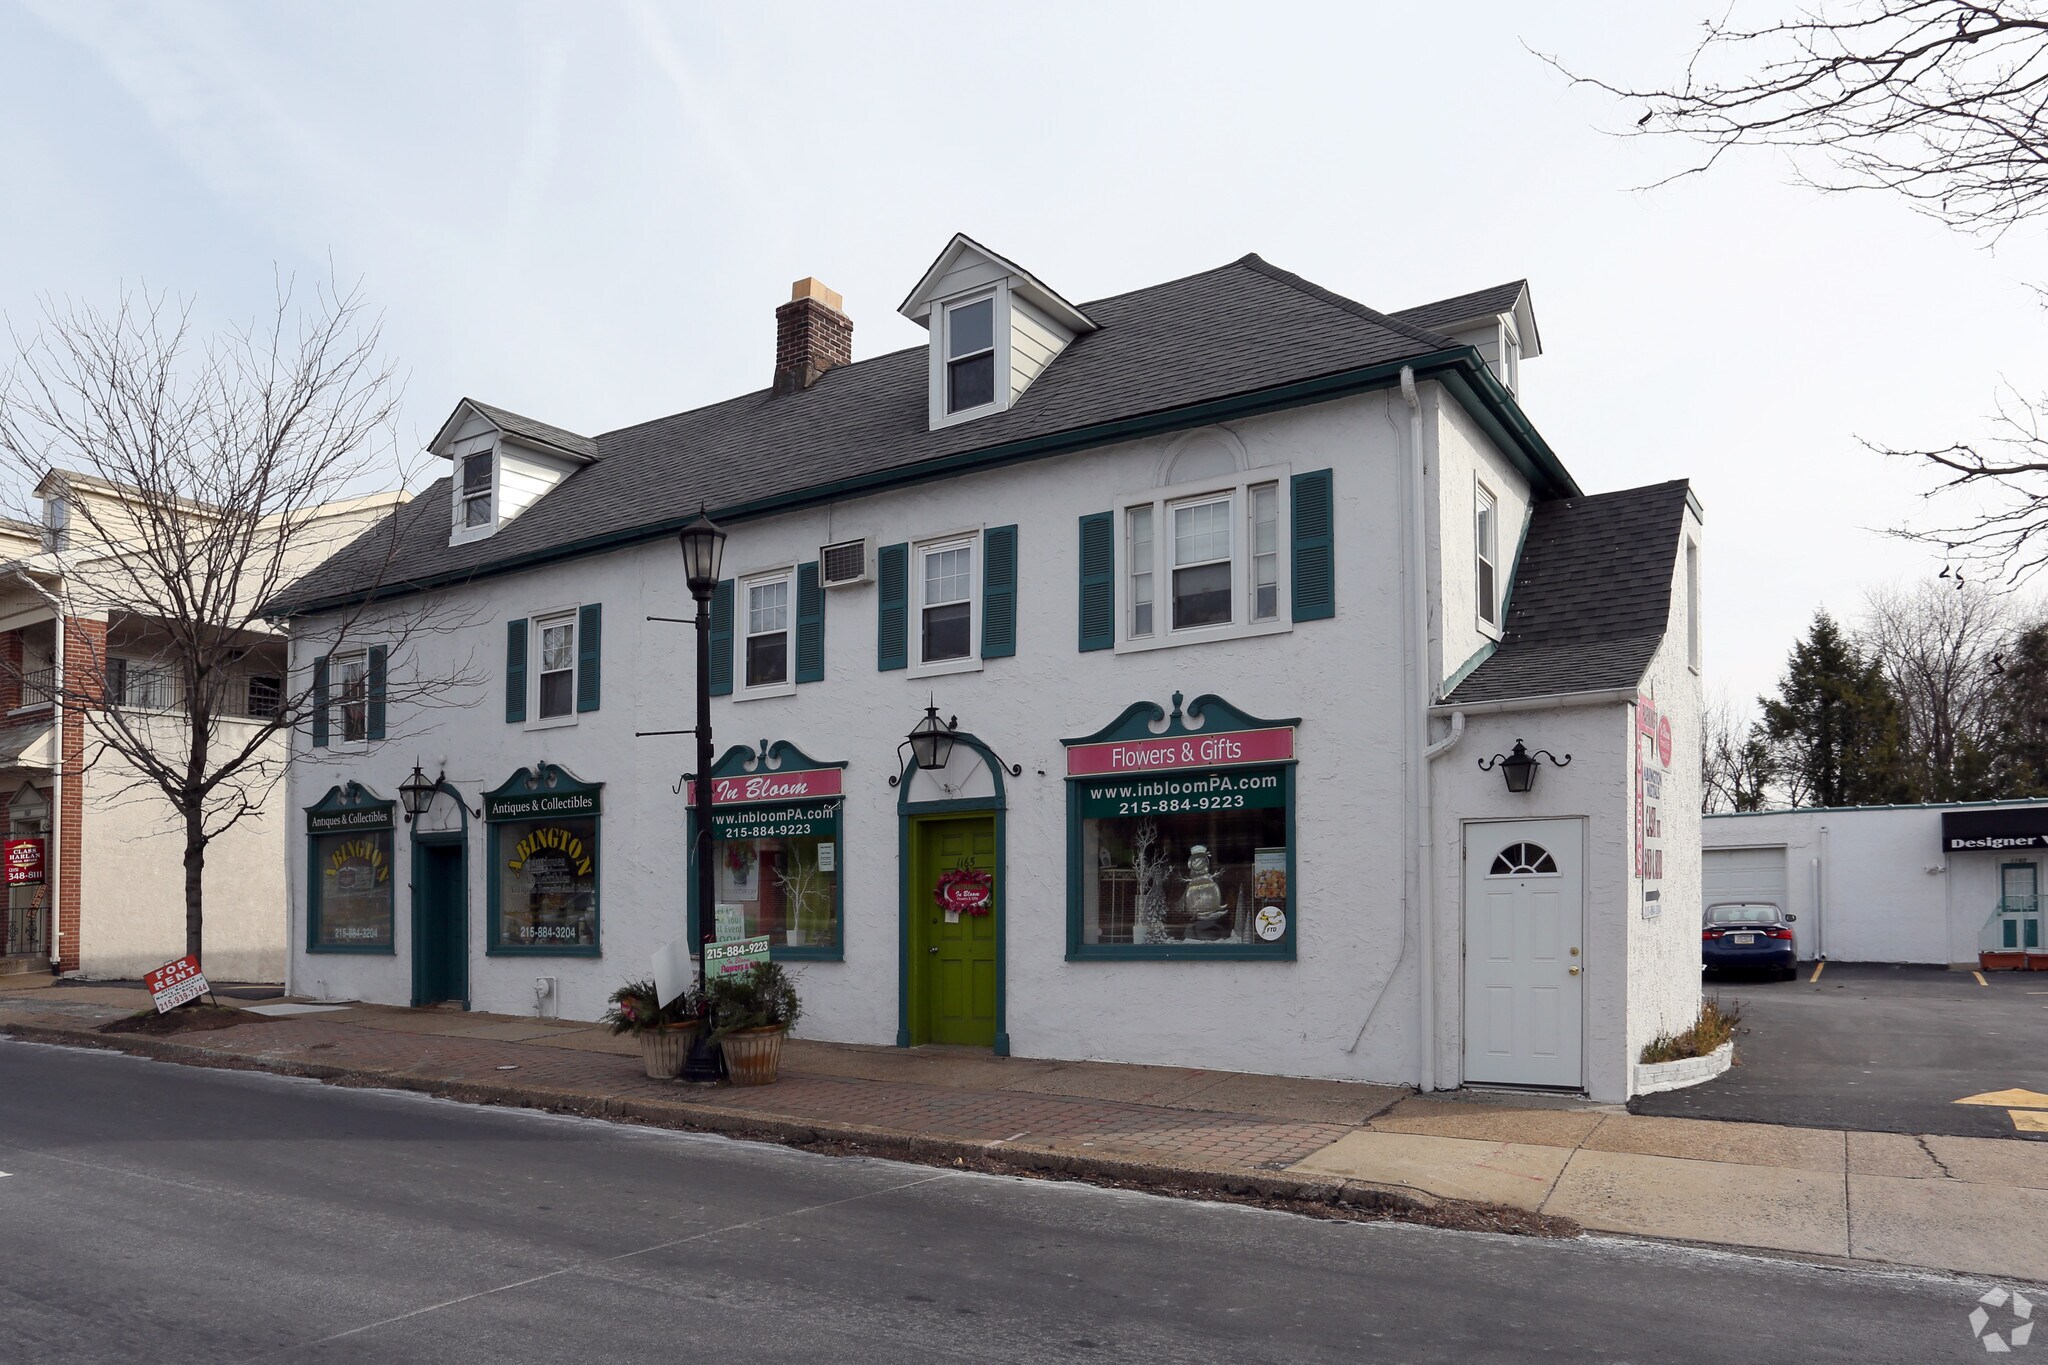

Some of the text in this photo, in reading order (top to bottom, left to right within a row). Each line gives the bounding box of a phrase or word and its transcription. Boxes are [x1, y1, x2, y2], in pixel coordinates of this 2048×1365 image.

[1112, 738, 1242, 767] Flowers & Gifts
[716, 779, 808, 800] In Bloom
[1090, 774, 1277, 799] www.inbloomPA.com
[492, 795, 592, 815] Antiques & Collectibles
[1119, 795, 1245, 815] 215-884-9223
[311, 810, 387, 828] Antiques & Collectibles
[712, 808, 833, 825] ww.inbloomPA.com
[726, 824, 811, 838] 215-884-9223
[13, 848, 37, 856] CLASS
[1951, 836, 2037, 849] Designer
[9, 852, 40, 861] HARLAN
[325, 840, 389, 882] ABINGTON
[508, 827, 592, 879] ABINGTON
[957, 857, 975, 867] 1165
[8, 870, 42, 881] 348-8111
[520, 926, 576, 938] 215-884-3204
[706, 941, 768, 960] 215-884-9223
[153, 966, 195, 991] RENT
[155, 960, 188, 980] FOR
[159, 983, 207, 1012] 215-939-7344
